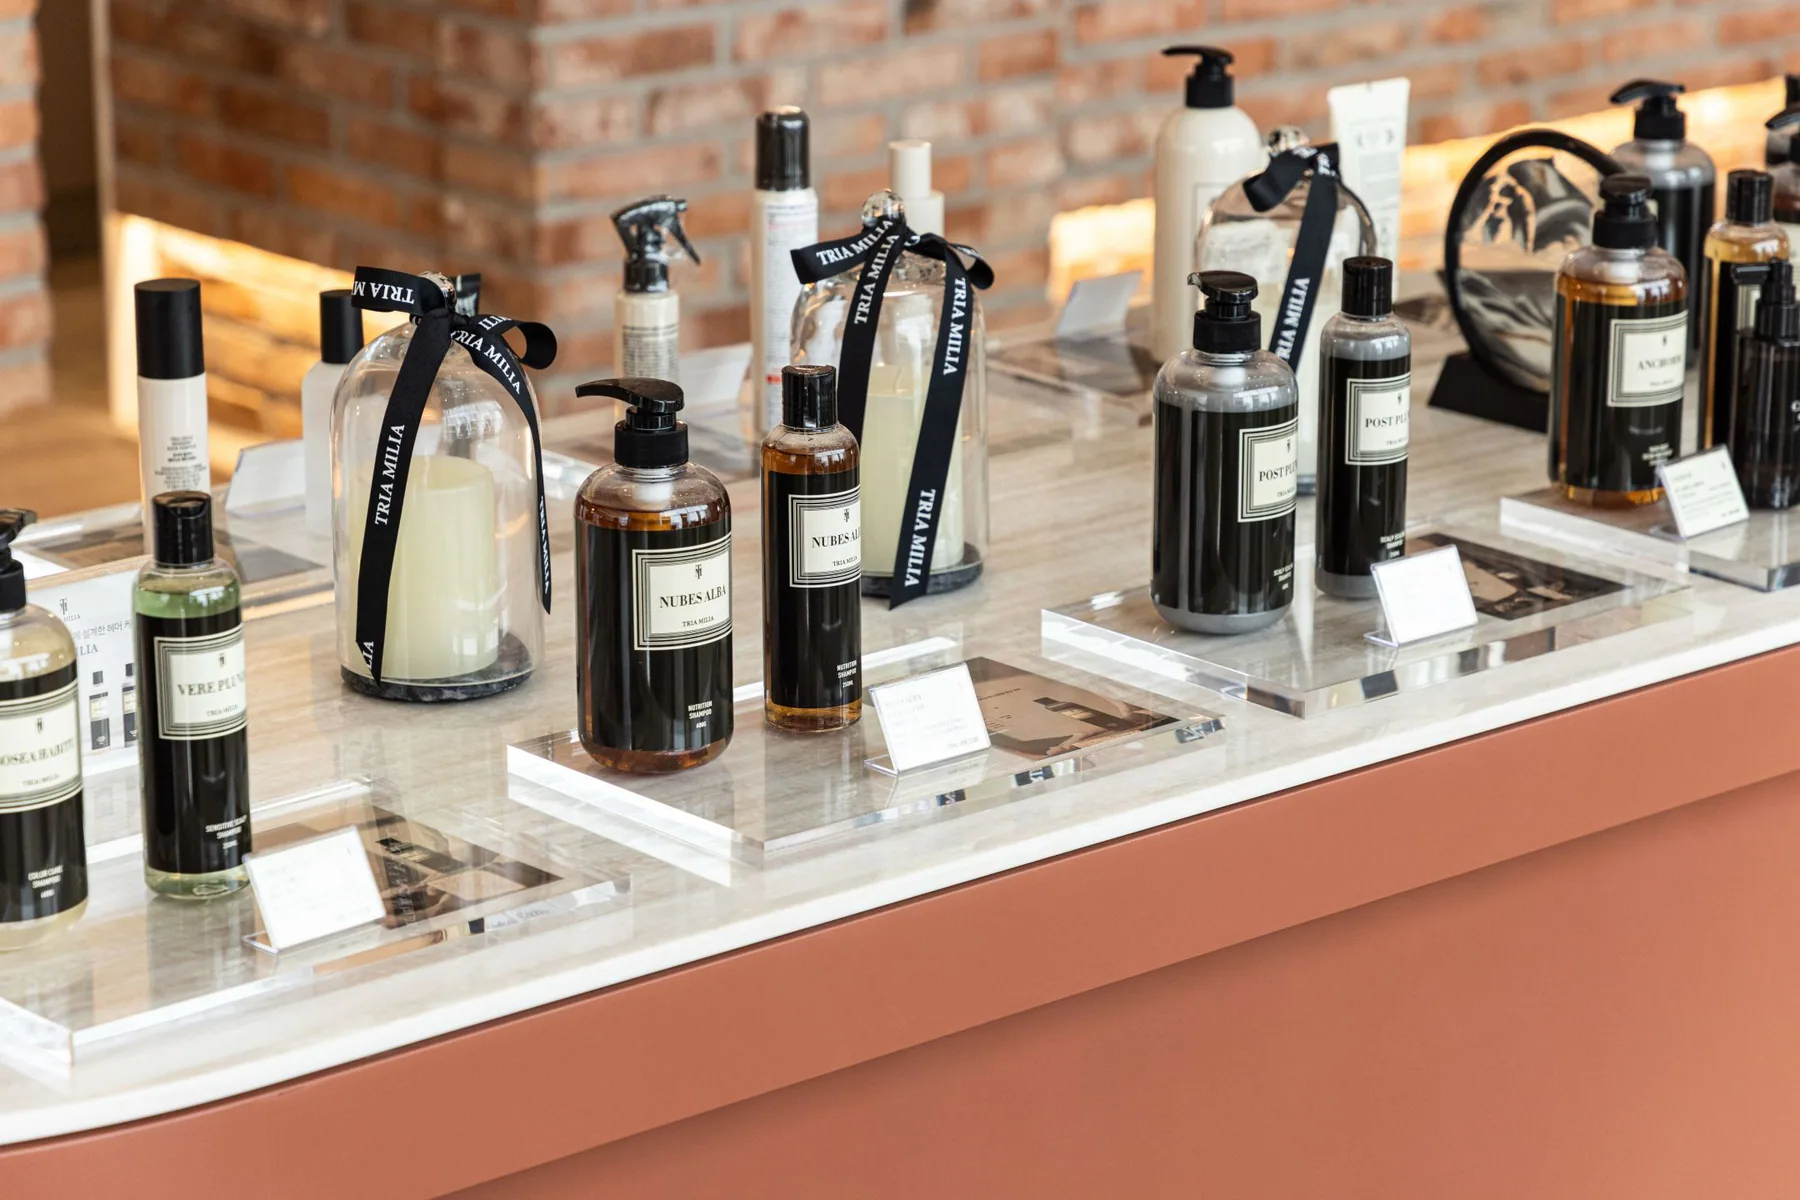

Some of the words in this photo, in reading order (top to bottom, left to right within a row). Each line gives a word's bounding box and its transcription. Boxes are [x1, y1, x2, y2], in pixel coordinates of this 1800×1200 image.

[816, 246, 852, 266] TRIA
[850, 219, 893, 254] MILIA
[370, 282, 415, 304] TRIA
[854, 281, 876, 324] TRIA
[867, 234, 899, 281] MILIA
[951, 277, 966, 321] TRIA
[1284, 277, 1311, 328] MILIA
[450, 329, 483, 352] TRIA
[483, 345, 521, 395] MILIA
[942, 325, 963, 375] MILIA
[1364, 416, 1394, 428] POST
[382, 424, 406, 479] MILIA
[1259, 466, 1284, 482] POST
[375, 482, 394, 526] TRIA
[913, 489, 936, 531] TRIA
[812, 533, 849, 548] NUBES
[904, 534, 927, 587] MILIA
[542, 540, 550, 594] MILIA
[659, 591, 702, 609] NUBES
[704, 584, 726, 603] ALBA
[682, 620, 698, 628] TRIA
[698, 615, 715, 625] MILIA
[80, 643, 99, 656] LIA
[177, 682, 216, 696] VERE
[688, 700, 713, 711] NUTRITION
[688, 708, 712, 719] SHAMPOO
